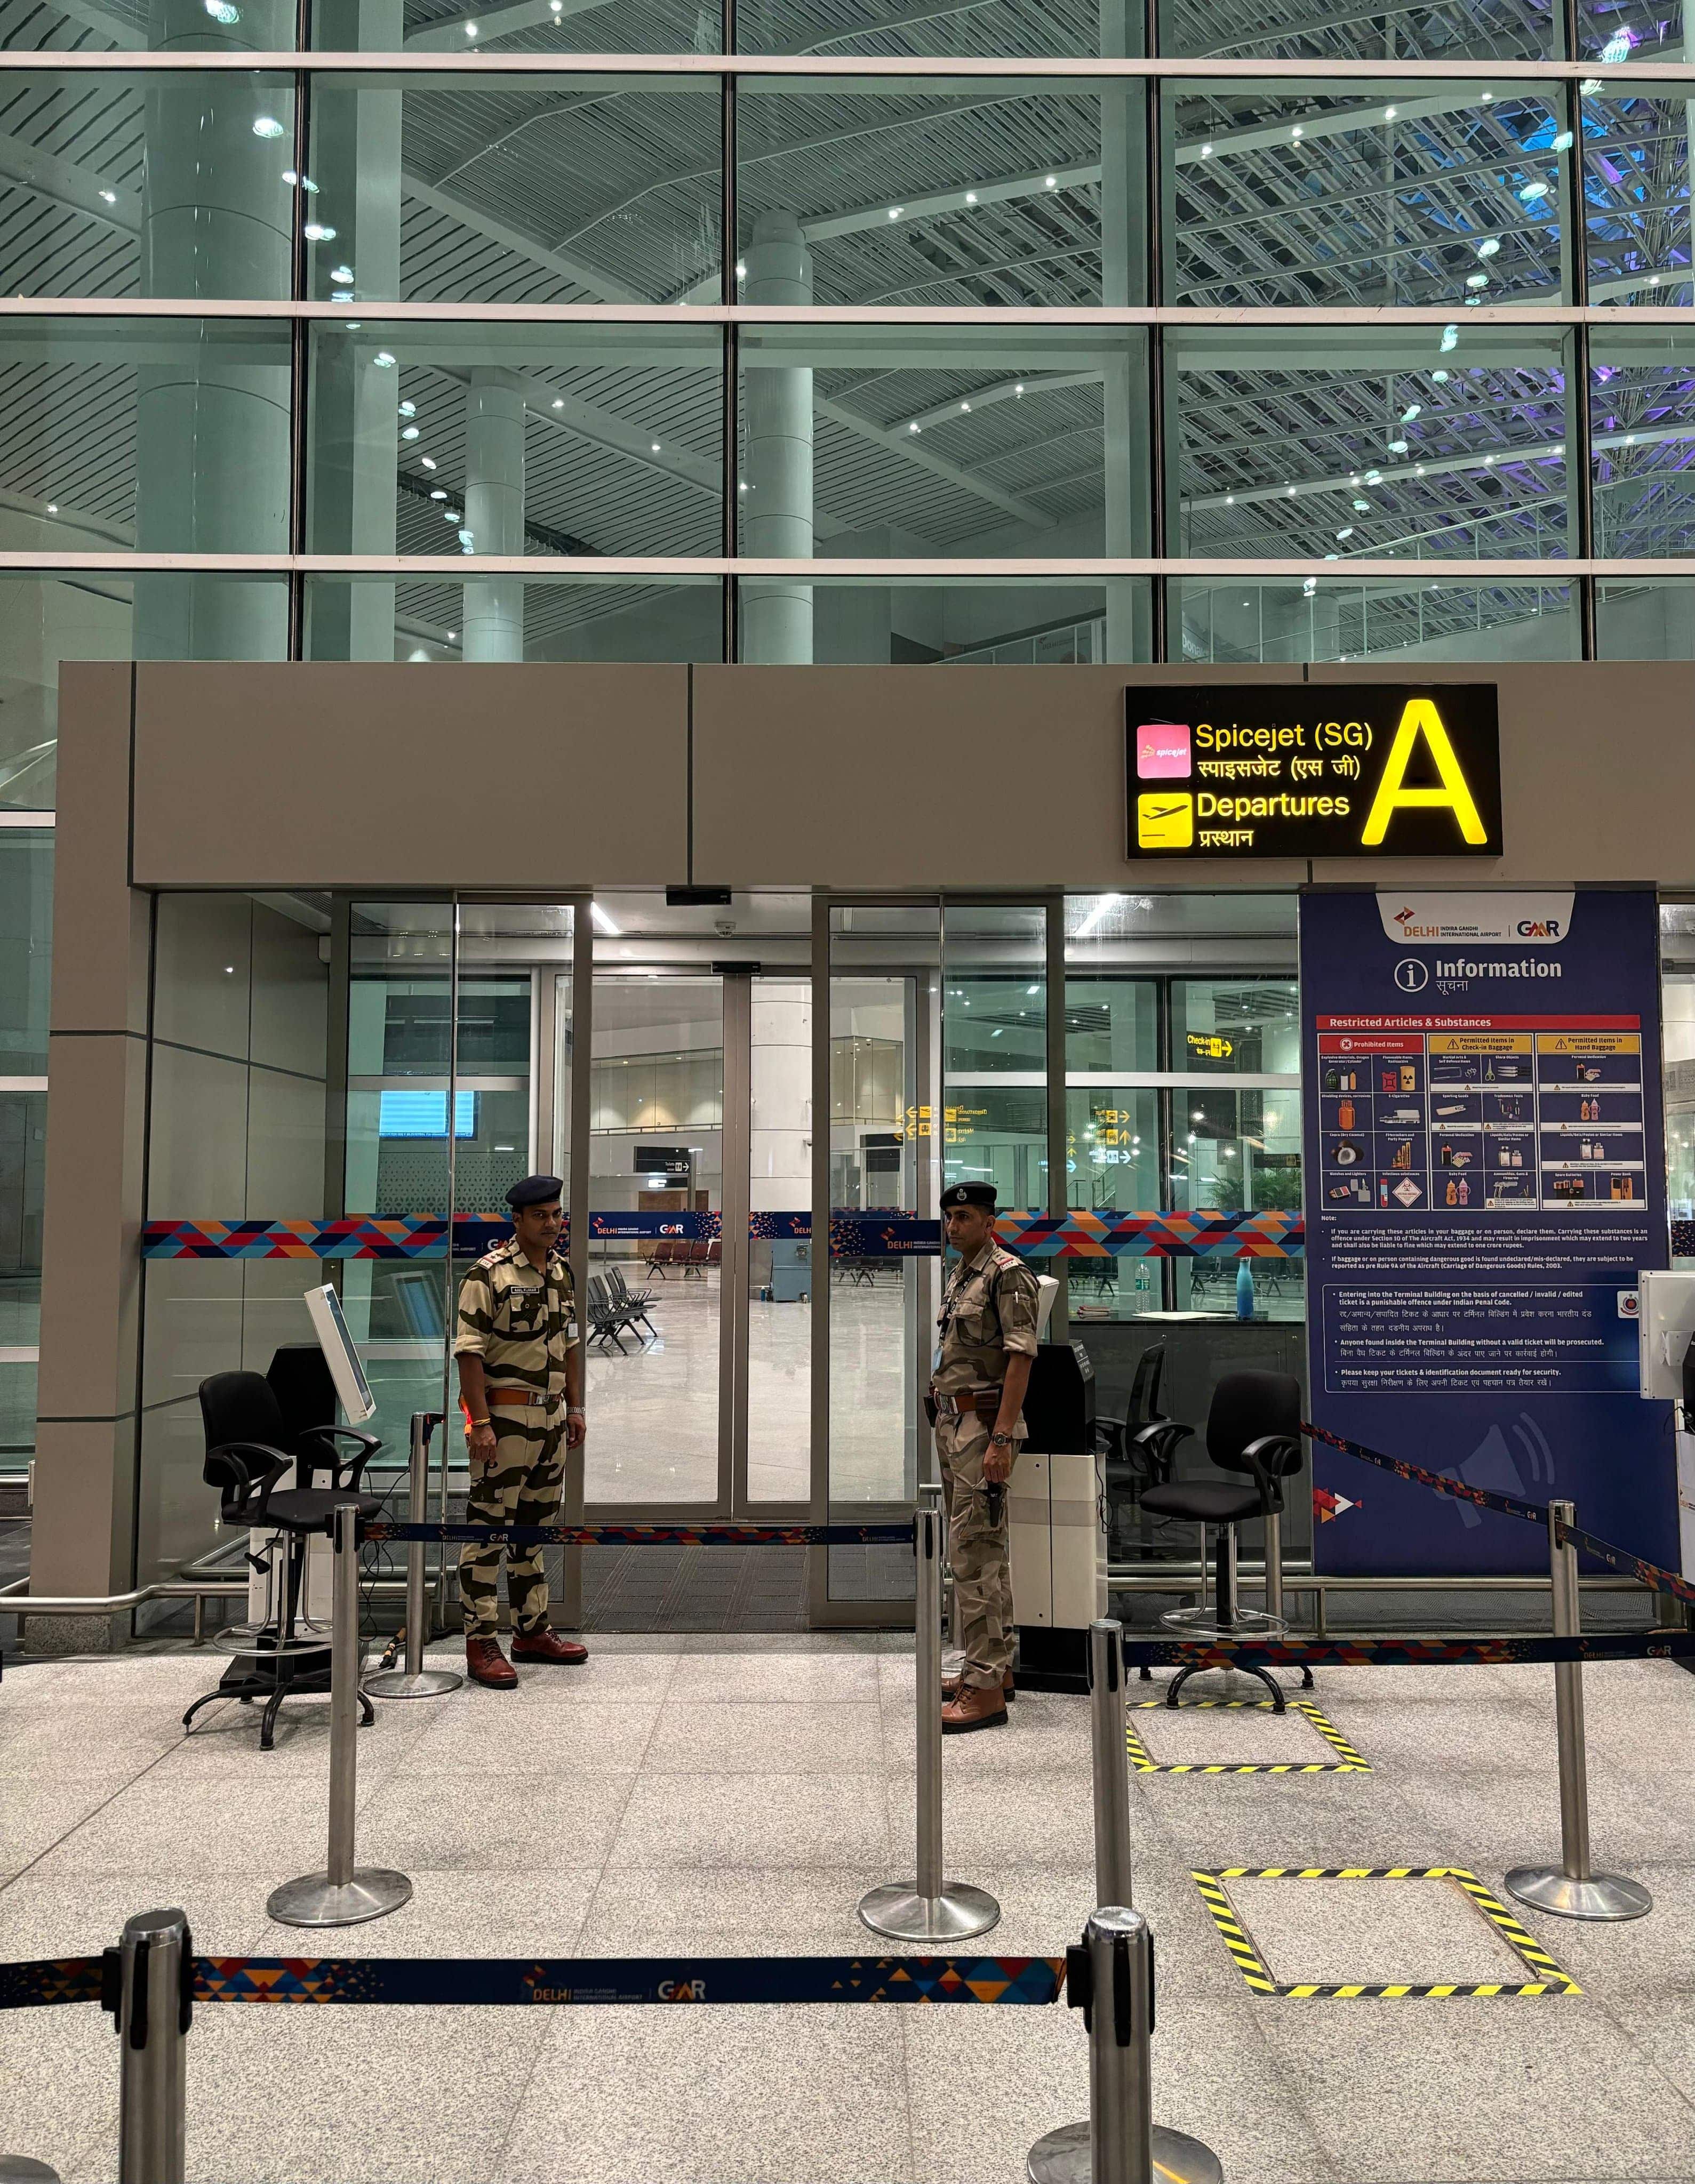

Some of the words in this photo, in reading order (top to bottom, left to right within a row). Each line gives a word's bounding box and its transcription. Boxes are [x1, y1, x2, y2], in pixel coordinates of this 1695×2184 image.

[1196, 724, 1305, 751] Spicejet
[1315, 722, 1373, 751] (SG)
[1156, 746, 1187, 758] spicejet
[1198, 757, 1281, 778] स्पाइसजेट
[1291, 757, 1322, 780] (एस
[1332, 755, 1360, 780] जी)
[1362, 700, 1487, 845] A
[1197, 793, 1350, 821] Departures
[1200, 830, 1254, 847] प्रस्थान
[1404, 926, 1439, 937] DELHI
[1517, 920, 1560, 937] GMR
[1436, 959, 1562, 978] Information
[1436, 980, 1468, 995] सूचना
[1330, 1017, 1382, 1027] Restricted
[1384, 1017, 1423, 1027] Articles
[1425, 1018, 1433, 1027] &
[1435, 1017, 1491, 1027] Substances
[1187, 1035, 1211, 1046] Check-in
[888, 1241, 913, 1250] DELHI
[533, 1988, 572, 2002] DELHI
